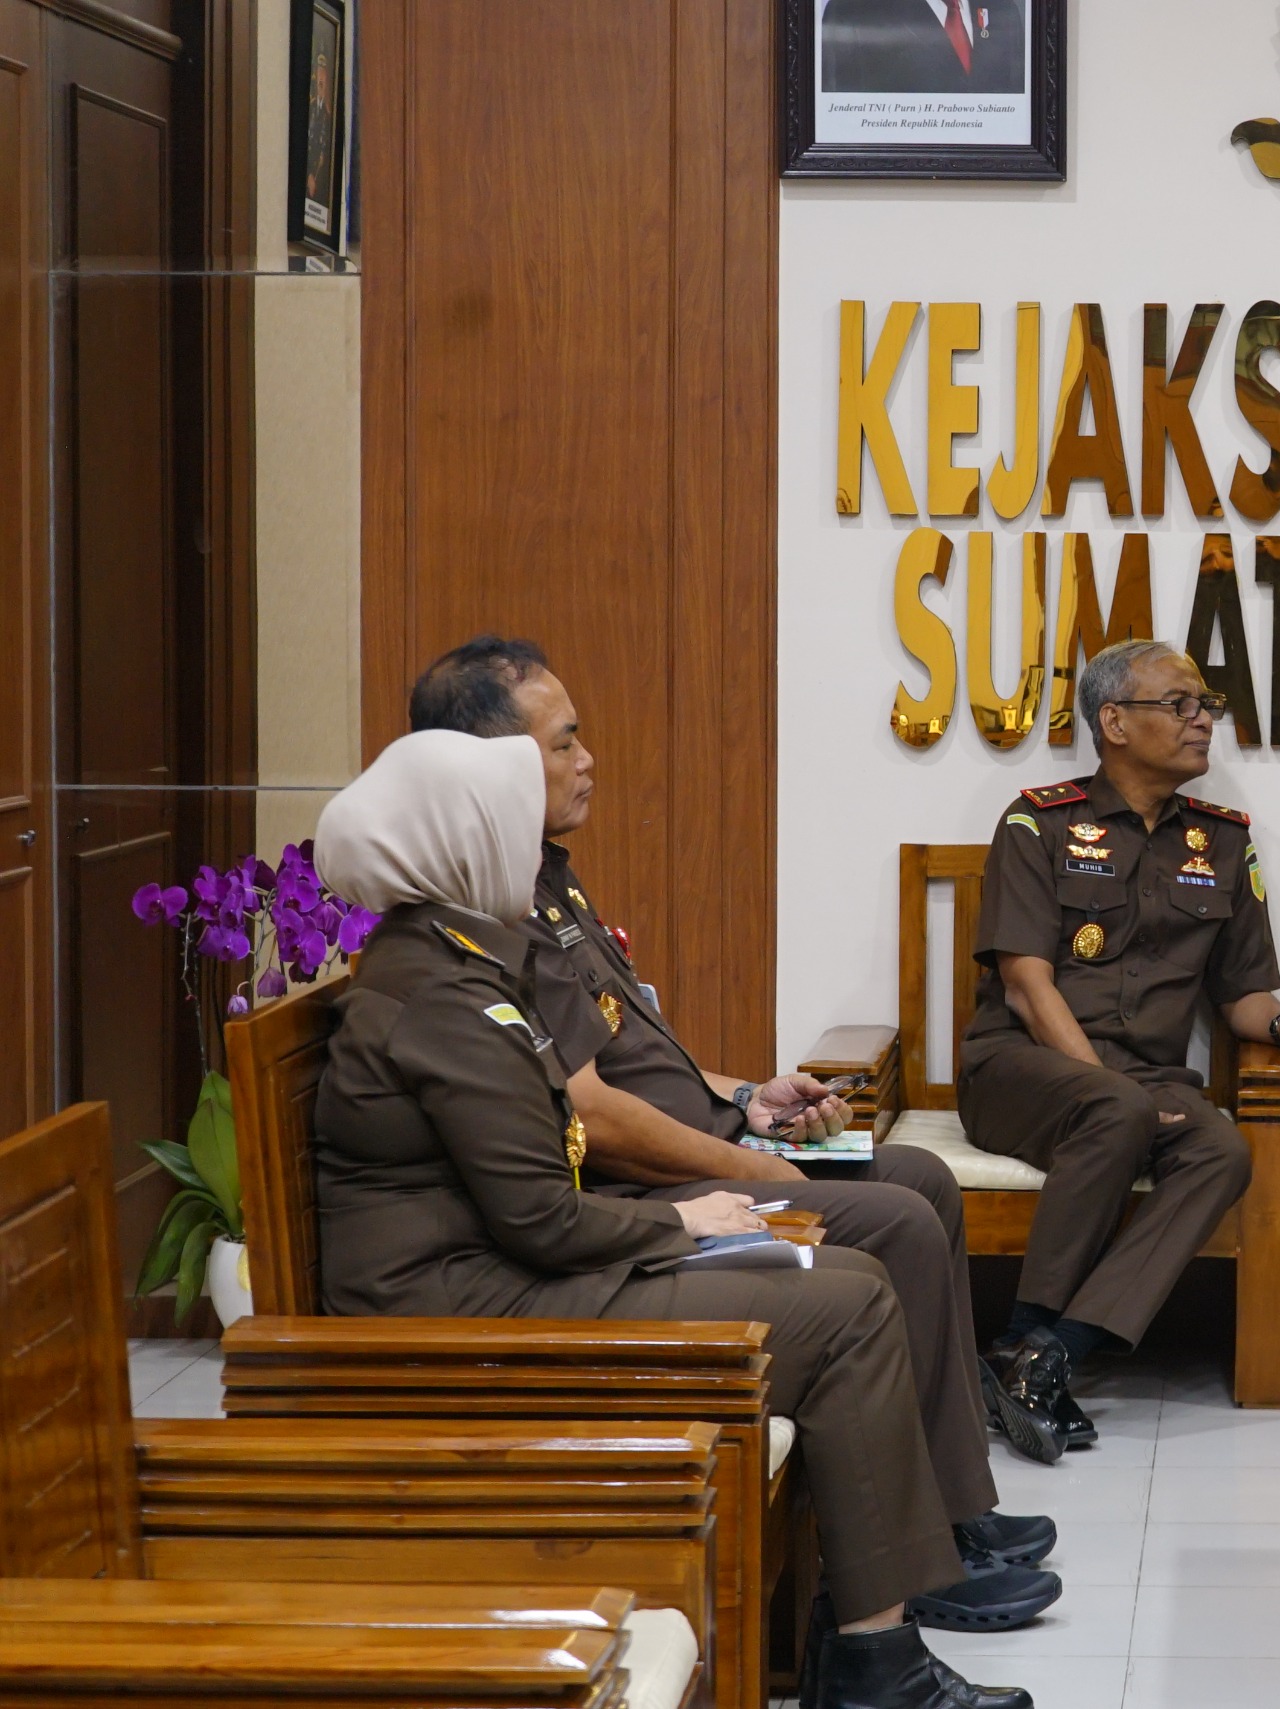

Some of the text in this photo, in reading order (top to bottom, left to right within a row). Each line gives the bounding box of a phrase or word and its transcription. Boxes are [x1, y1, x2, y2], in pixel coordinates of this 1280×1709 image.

[828, 103, 867, 113] Jenderal
[868, 103, 886, 112] TNI
[924, 103, 935, 113] H.
[937, 103, 975, 113] Prabowo
[976, 103, 1016, 113] Subianto
[860, 118, 983, 130] Presiden Republik Indonesia
